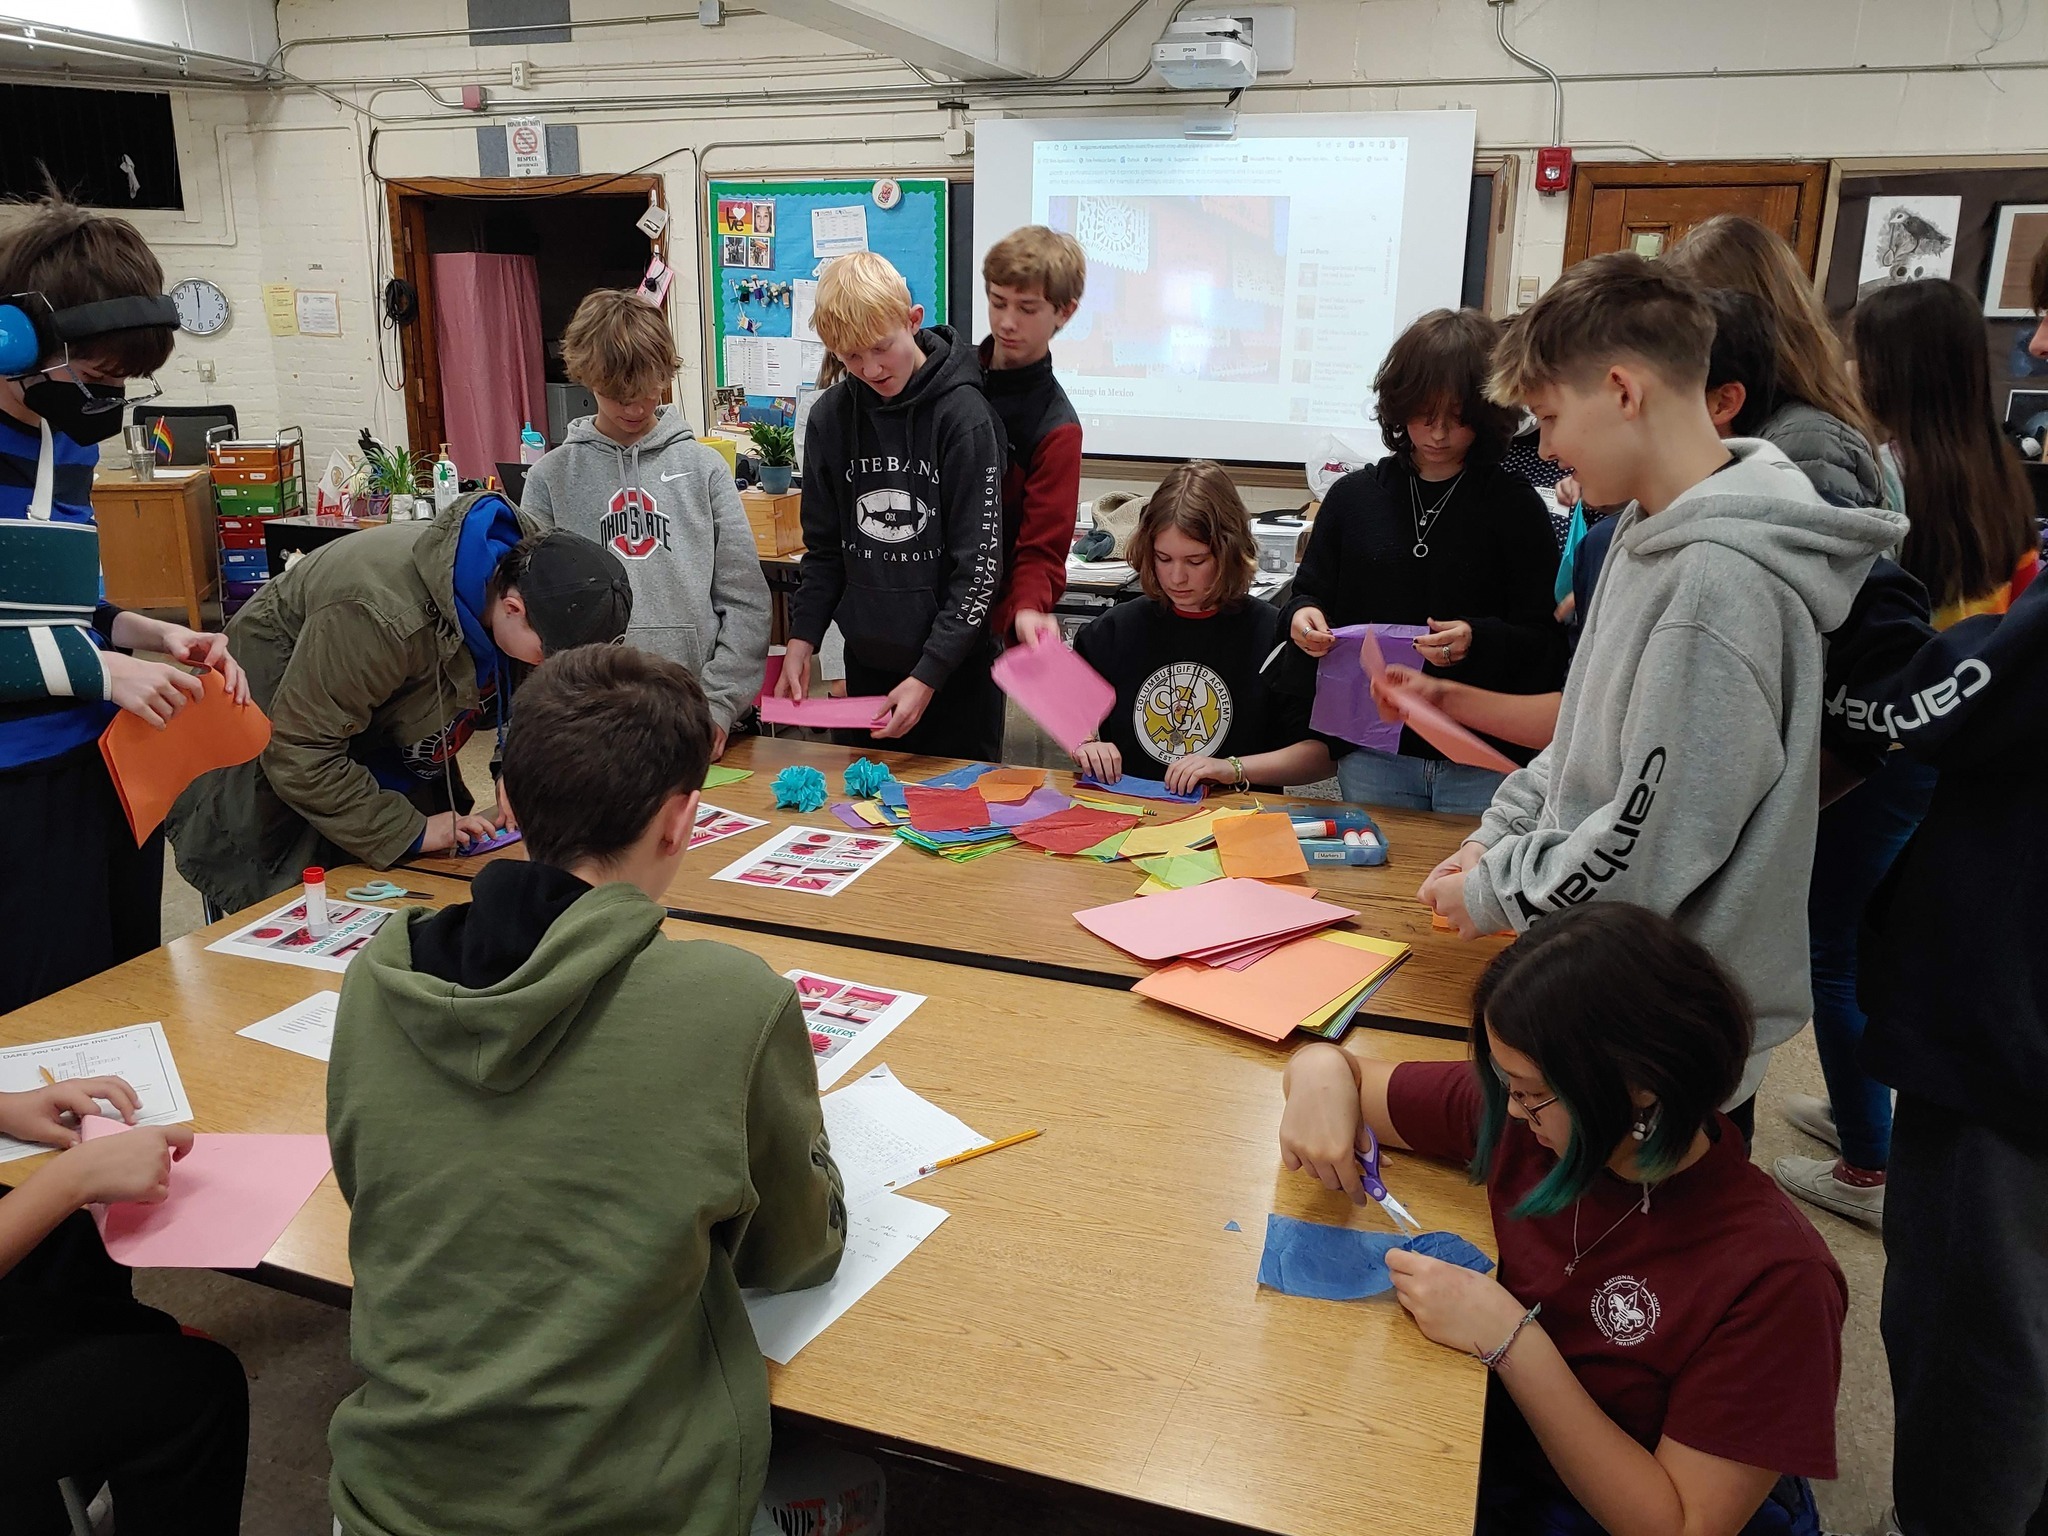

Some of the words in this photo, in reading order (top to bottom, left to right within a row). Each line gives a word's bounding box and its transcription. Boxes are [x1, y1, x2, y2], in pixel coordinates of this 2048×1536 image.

[183, 285, 191, 293] 11
[192, 283, 201, 291] 12
[175, 292, 184, 300] 10
[214, 293, 220, 302] 2
[218, 303, 224, 311] 3
[187, 319, 193, 327] 7
[198, 322, 204, 330] 6
[1107, 388, 1134, 397] Mexico
[982, 475, 994, 531] NORTH
[955, 543, 988, 620] CAROLINA
[966, 556, 998, 628] BANKS
[1136, 669, 1172, 712] COLUMBUS
[1176, 665, 1209, 677] GIFTED
[1210, 676, 1230, 722] ACADEMY
[770, 852, 806, 861] FLOWERS
[812, 1022, 857, 1038] FLOWERS
[3, 1052, 29, 1060] DARE
[63, 1042, 90, 1050] figure
[1603, 1275, 1635, 1287] NATIONAL
[1651, 1292, 1661, 1318] YOUTH
[1590, 1295, 1608, 1337] LEADERSHIP
[1615, 1336, 1646, 1347] TRAINING
